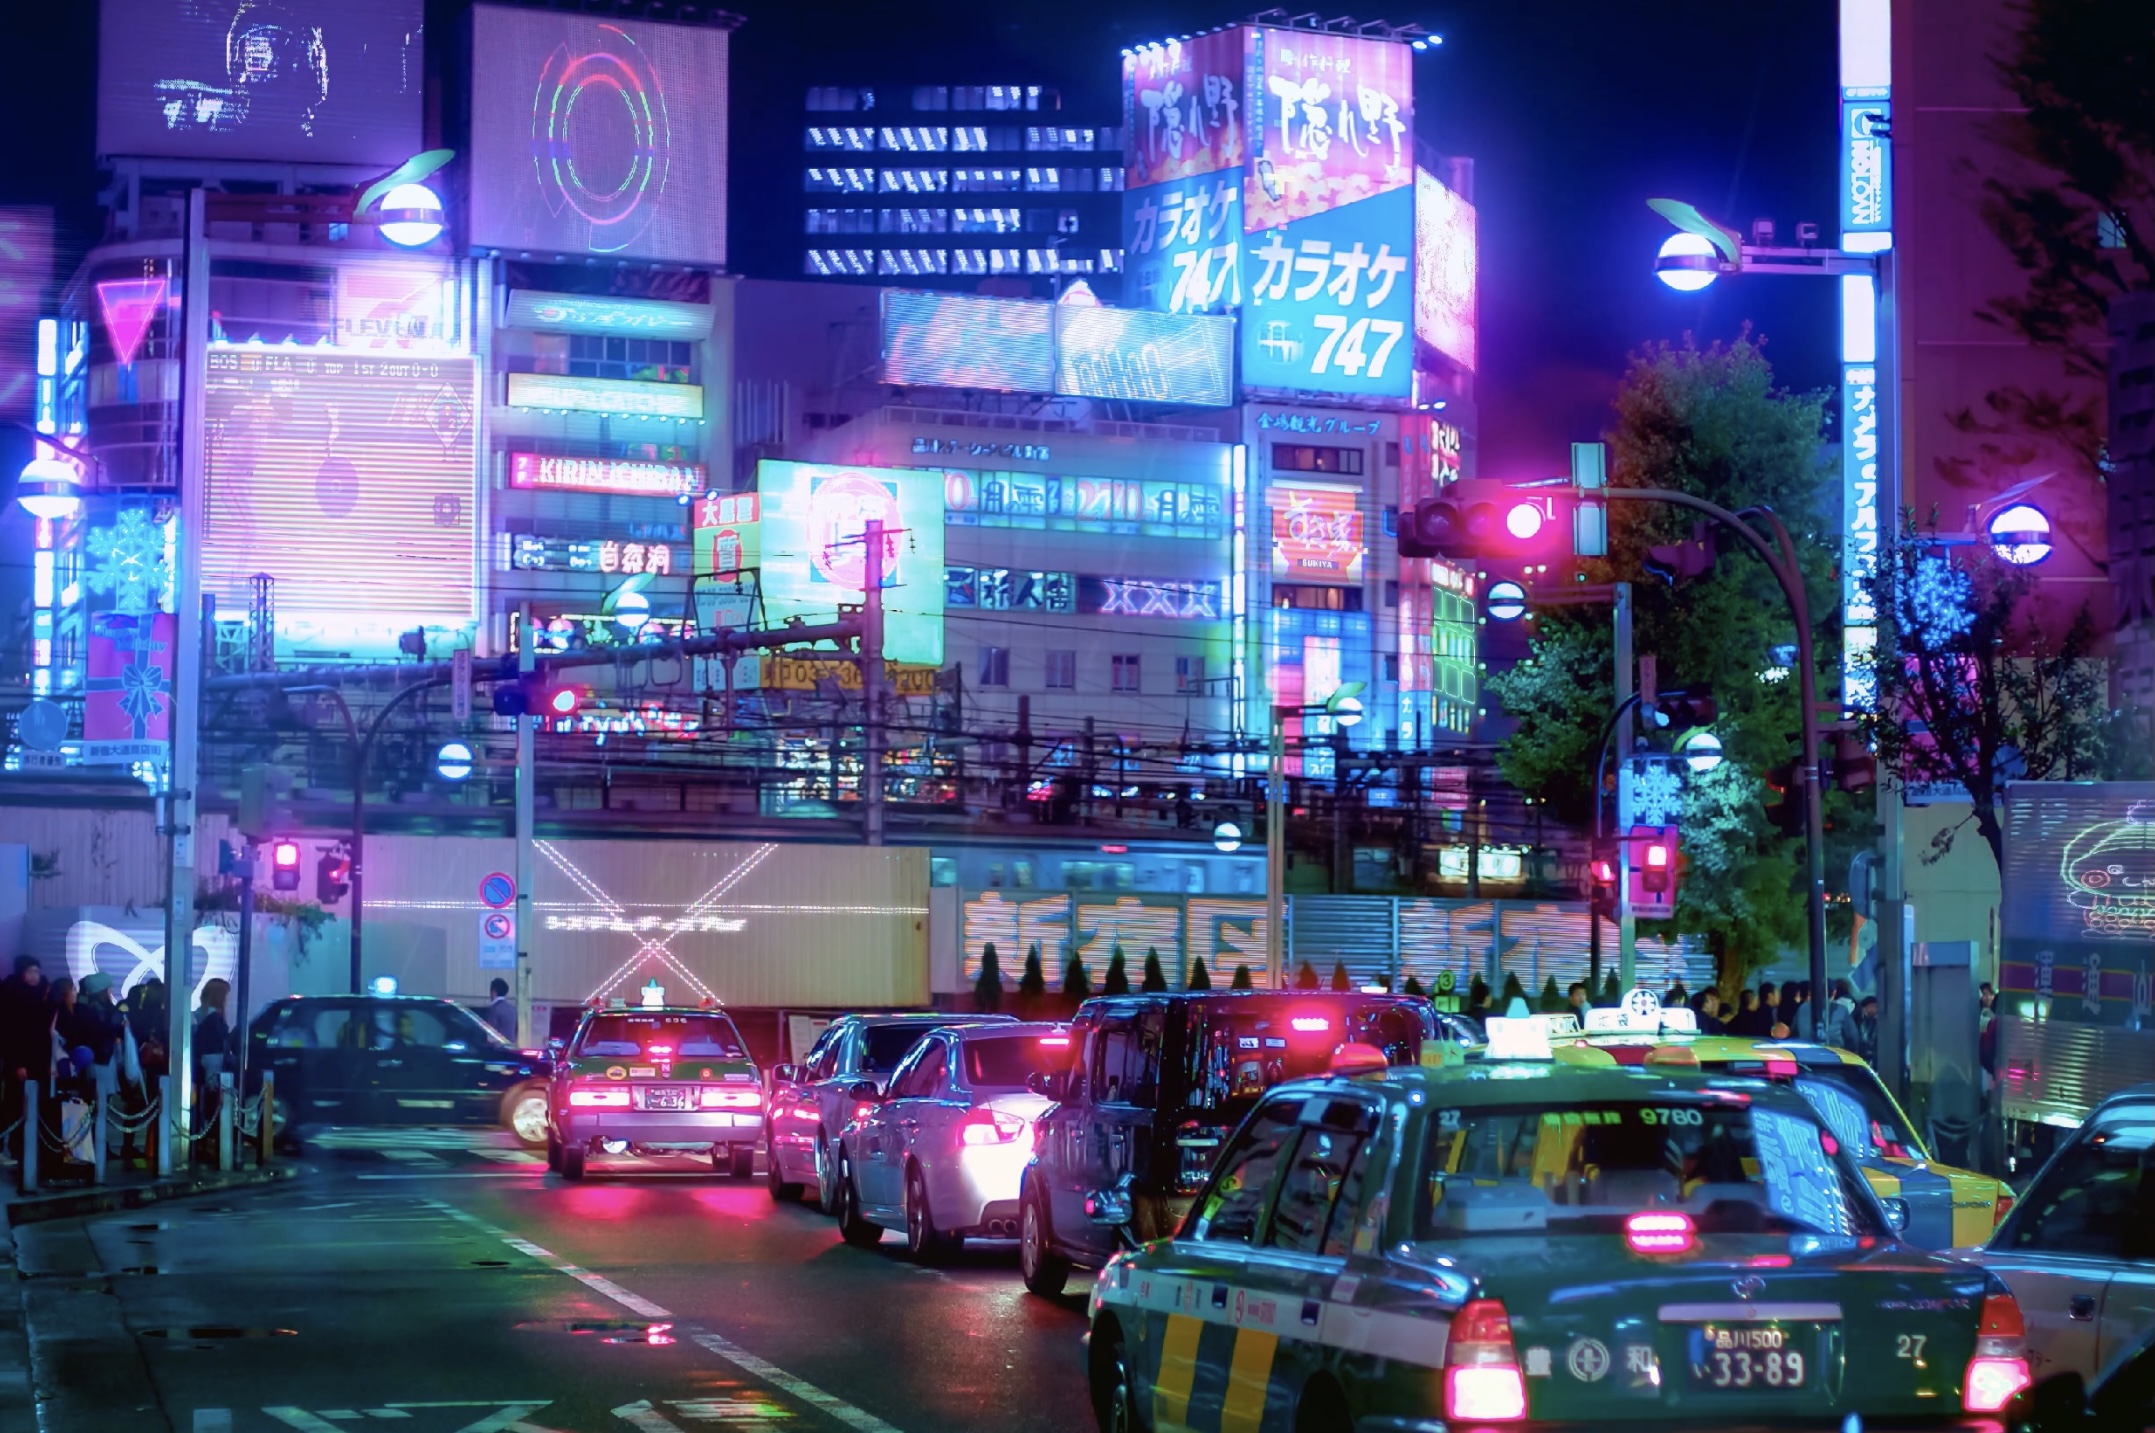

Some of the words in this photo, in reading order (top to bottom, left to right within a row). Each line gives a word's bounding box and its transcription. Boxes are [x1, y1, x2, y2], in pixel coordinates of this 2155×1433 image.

[1131, 180, 1237, 255] カラオケ
[1168, 241, 1241, 316] 747
[1251, 234, 1408, 309] カラオケ
[1310, 313, 1405, 378] 747
[210, 354, 237, 370] BOS
[265, 356, 292, 371] FLA
[539, 457, 603, 486] KIRIN
[1302, 559, 1333, 569] SUKIYA
[1639, 1109, 1703, 1125] 9780
[1896, 1334, 1928, 1357] 27
[1714, 1352, 1804, 1386] 33-89
